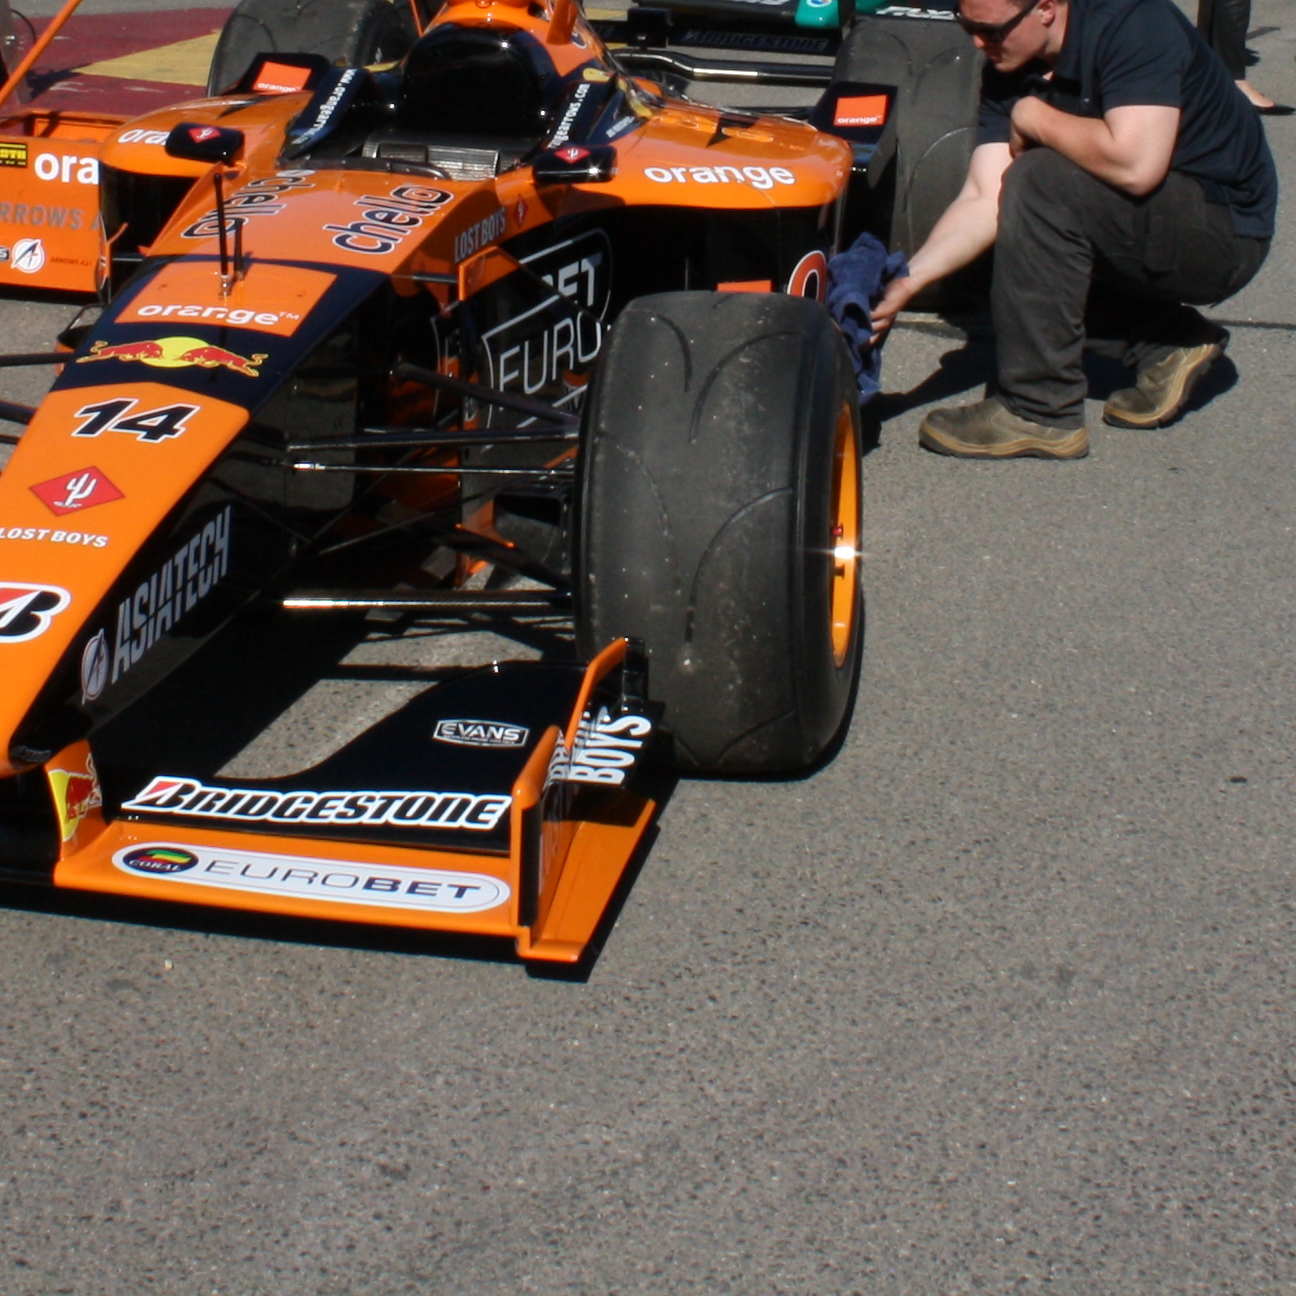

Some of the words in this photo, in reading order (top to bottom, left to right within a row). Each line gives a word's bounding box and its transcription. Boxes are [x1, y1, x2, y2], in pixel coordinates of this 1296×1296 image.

[643, 166, 796, 190] orange
[322, 184, 455, 255] chello
[137, 304, 280, 326] orange
[70, 397, 201, 444] 14
[50, 529, 109, 548] BOYS
[111, 505, 232, 685] ASIATECH
[441, 722, 521, 741] EVANS
[568, 714, 652, 786] BOYS
[122, 776, 512, 829] BRIDGESTONE
[128, 859, 182, 872] CORAL
[205, 859, 481, 900] EUROBET
